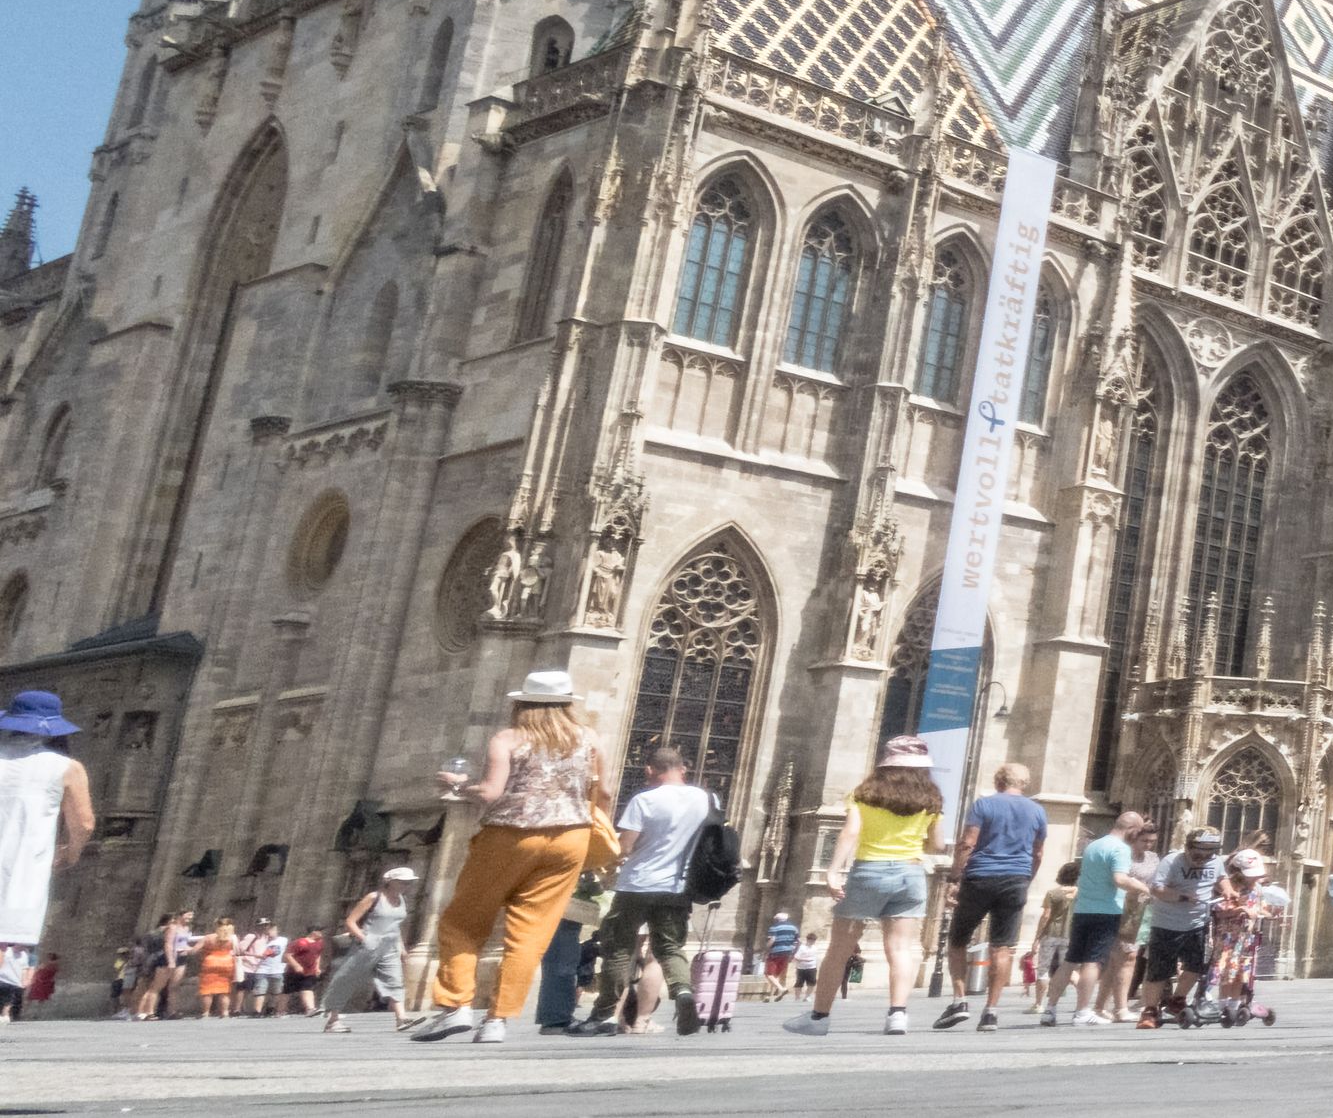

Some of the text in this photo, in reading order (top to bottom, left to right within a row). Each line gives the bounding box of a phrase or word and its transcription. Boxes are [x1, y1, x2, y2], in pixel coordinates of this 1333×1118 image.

[961, 221, 1041, 589] wertvoll tatkräftig
[1182, 867, 1216, 880] VANS
